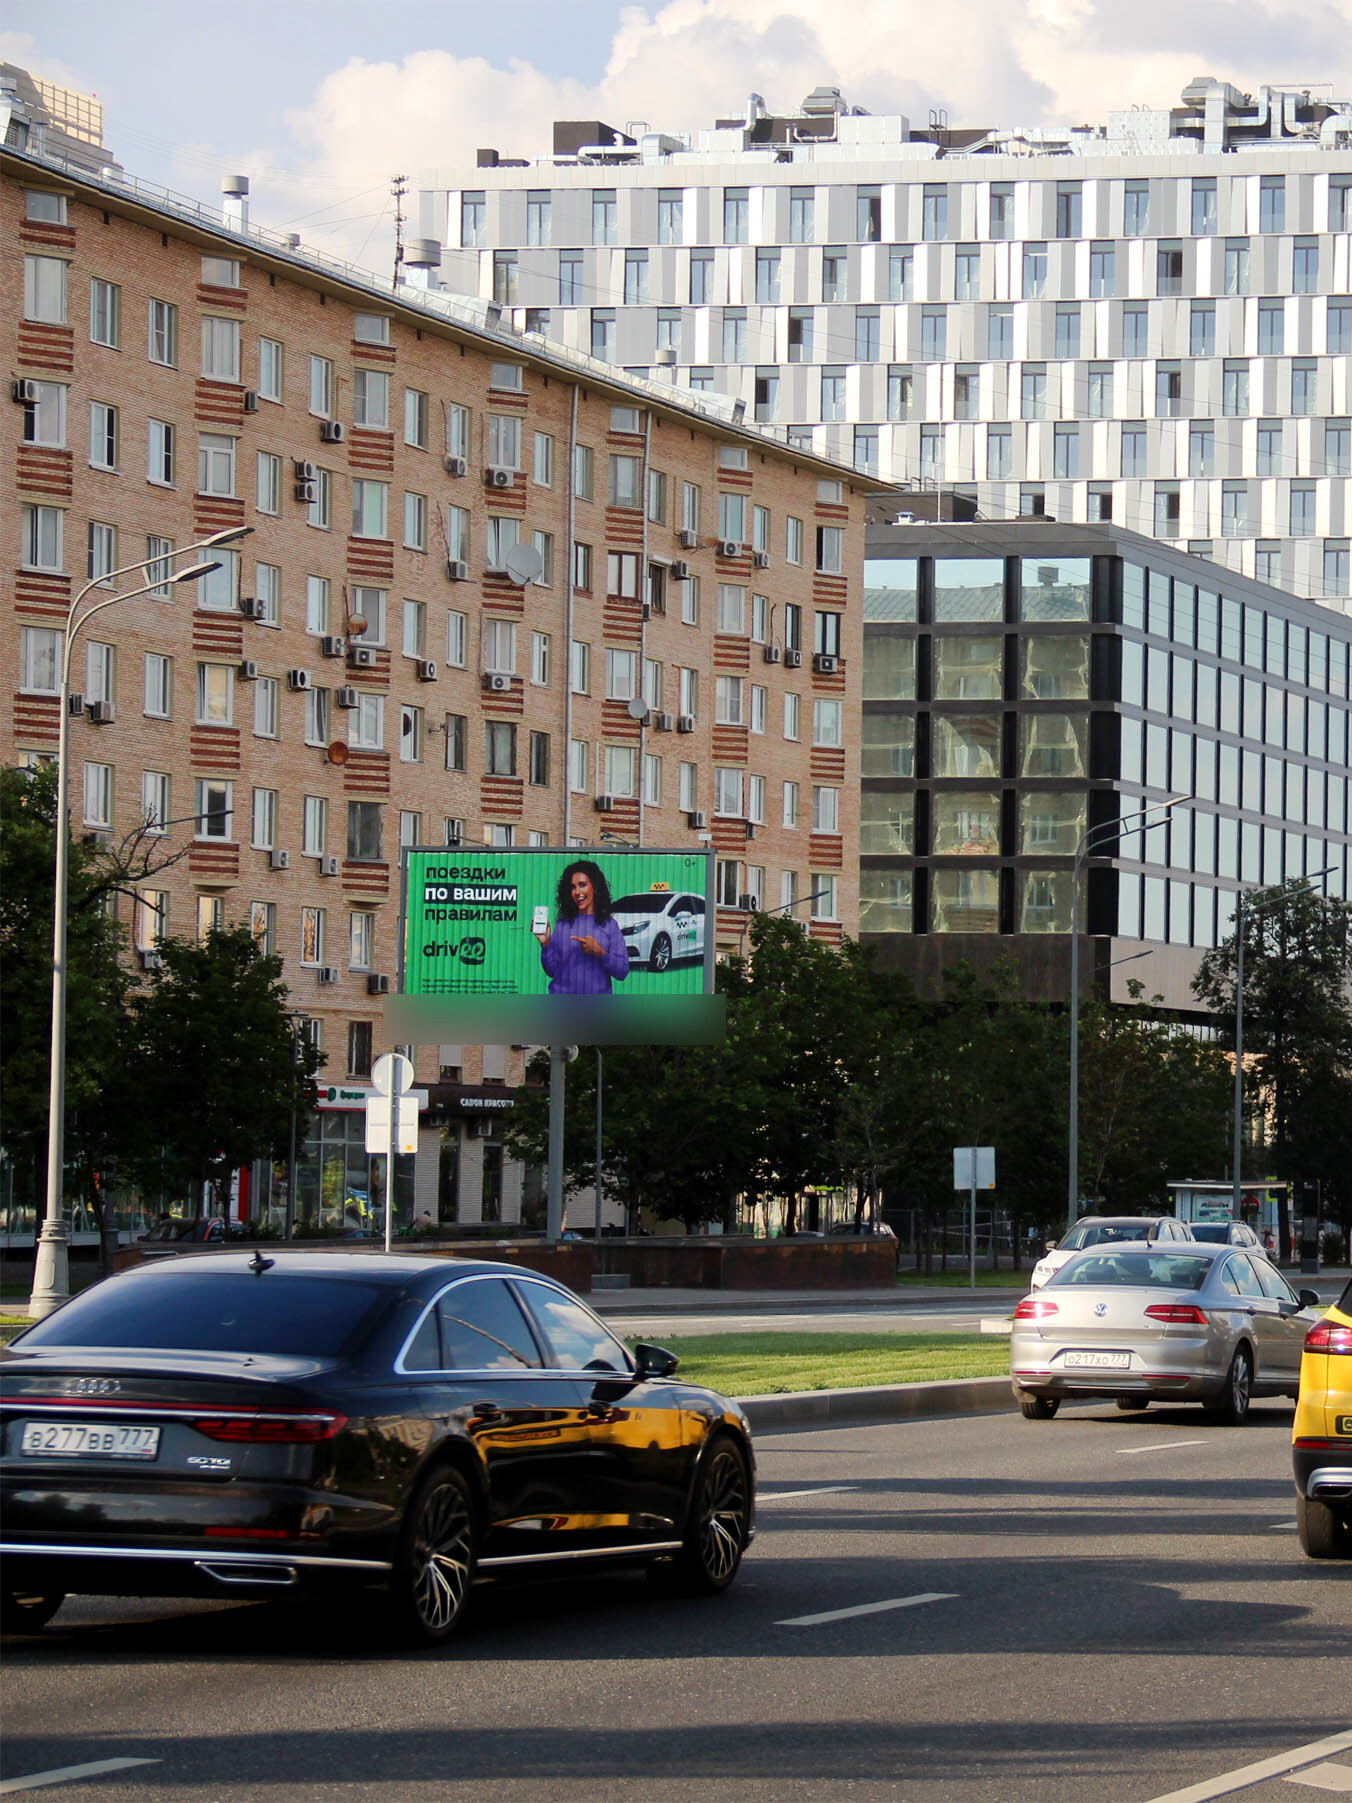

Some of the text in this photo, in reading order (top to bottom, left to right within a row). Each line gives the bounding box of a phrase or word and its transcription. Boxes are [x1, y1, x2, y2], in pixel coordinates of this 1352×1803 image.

[684, 858, 696, 867] 0+
[426, 866, 506, 882] поездки
[425, 887, 517, 901] по вашим
[425, 908, 517, 925] правилам
[31, 1426, 154, 1450] В277ВВ 777
